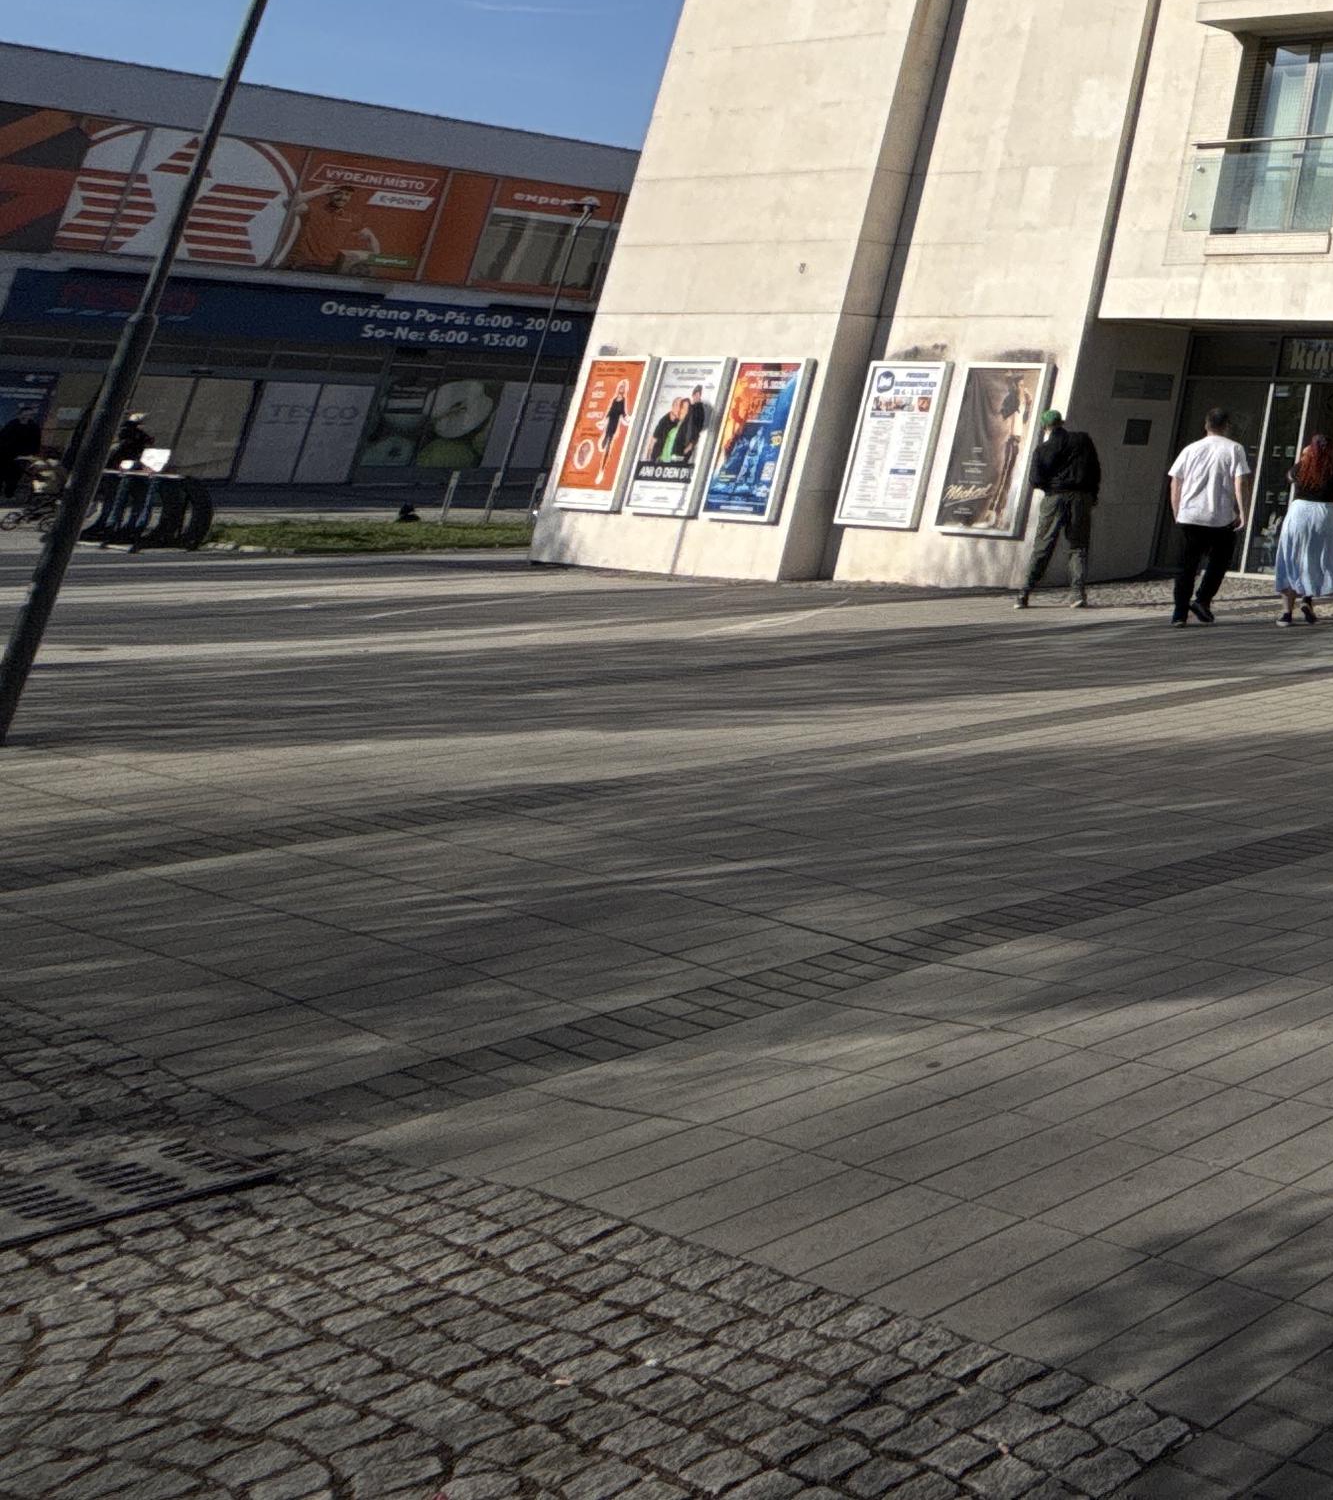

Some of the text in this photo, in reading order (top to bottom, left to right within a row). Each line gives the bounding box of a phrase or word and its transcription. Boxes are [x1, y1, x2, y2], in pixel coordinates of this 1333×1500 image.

[384, 178, 425, 190] MÍSTO
[320, 300, 411, 321] Otevřeno
[414, 308, 469, 326] Po-Pá:
[474, 313, 513, 329] 6:00
[524, 316, 573, 333] 2000
[361, 324, 425, 342] So-Ne:
[428, 329, 469, 344] 6:00
[482, 332, 529, 348] 13:00
